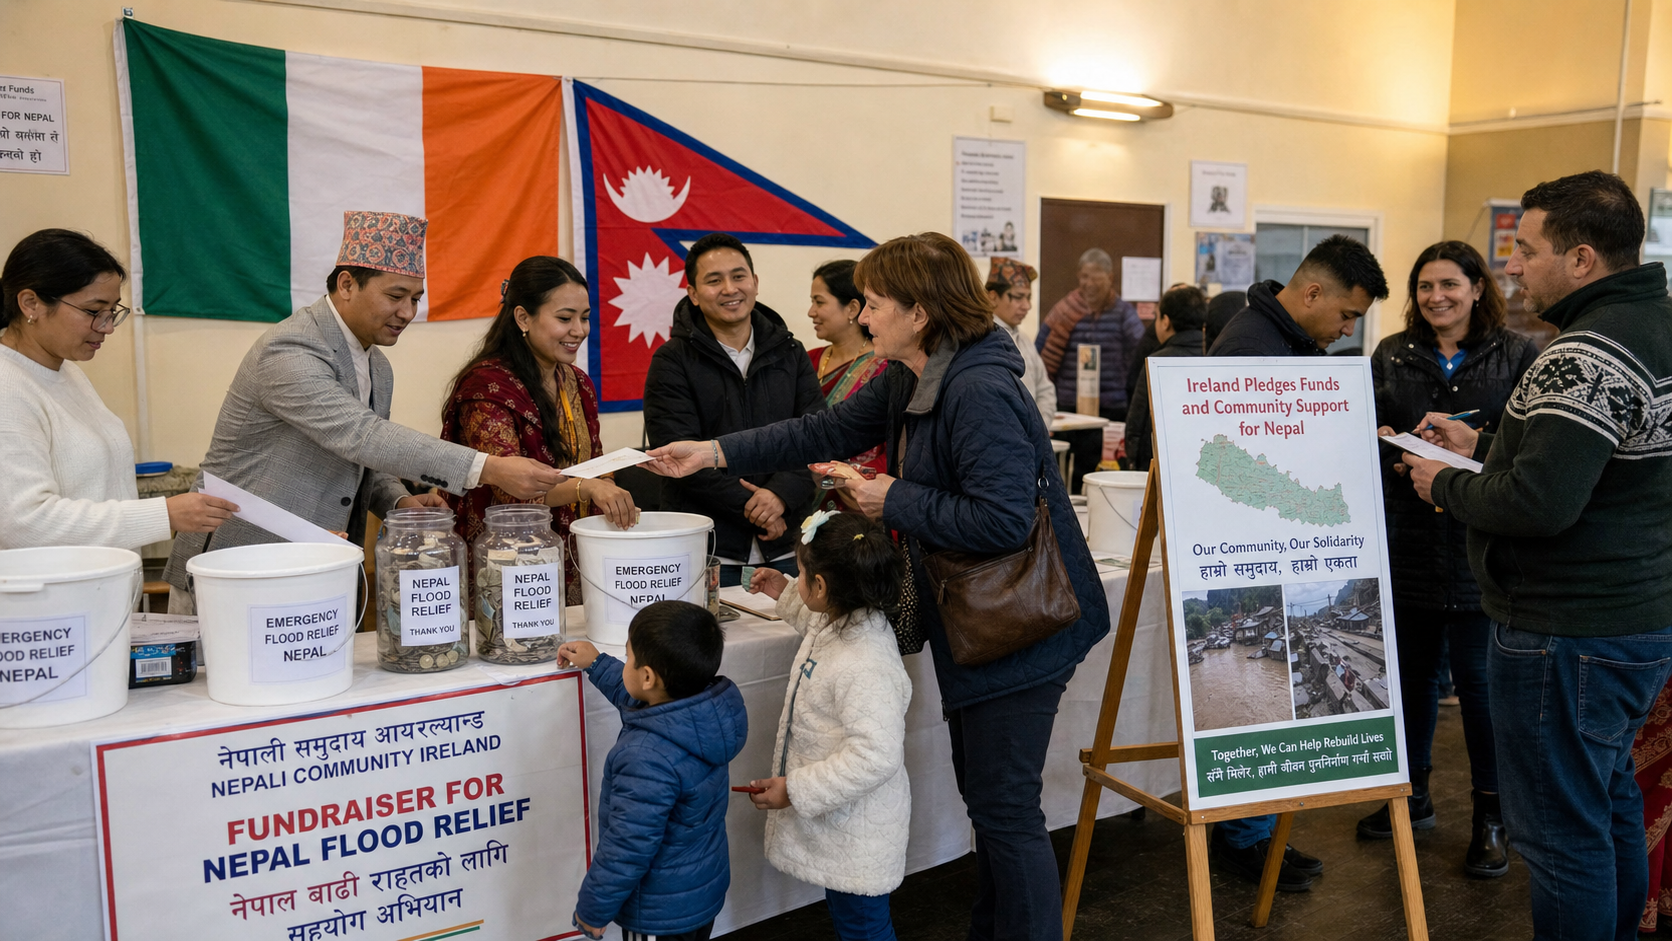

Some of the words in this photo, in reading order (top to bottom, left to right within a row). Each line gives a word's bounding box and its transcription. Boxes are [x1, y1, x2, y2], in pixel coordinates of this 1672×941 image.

[8, 84, 34, 94] Funds
[1, 111, 20, 120] FOR
[24, 112, 54, 122] NEPAL
[1186, 377, 1240, 393] Ireland
[1244, 377, 1297, 396] Pledges
[1300, 376, 1340, 392] Funds
[1182, 400, 1210, 415] and
[1214, 399, 1292, 418] Community
[1296, 398, 1350, 416] Support
[1238, 421, 1260, 436] for
[1264, 420, 1305, 440] Nepal
[1192, 543, 1216, 556] Our
[1220, 539, 1287, 555] Community,
[1289, 537, 1310, 550] Our
[1313, 534, 1365, 550] Solidarity
[615, 563, 682, 576] EMERGENCY
[1199, 560, 1227, 580] हाम्रो
[1234, 561, 1282, 580] समुदाय,
[1291, 554, 1318, 575] हाम्रो
[1324, 555, 1358, 572] एकता
[412, 577, 450, 589] NEPAL
[514, 572, 550, 584] NEPAL
[615, 580, 648, 590] FLOOD
[650, 577, 682, 589] RELIEF
[411, 590, 452, 603] FLOOD
[514, 586, 552, 598] FLOOD
[411, 604, 452, 616] RELIEF
[514, 598, 552, 610] RELIEF
[266, 608, 338, 628] EMERGENCY
[512, 620, 539, 630] THANK
[541, 618, 555, 626] YOU
[0, 628, 72, 644] ERGENCY
[265, 632, 304, 644] FLOOD
[307, 624, 339, 640] RELIEF
[410, 627, 438, 636] THANK
[440, 625, 455, 634] YOU
[29, 645, 75, 660] RELIEF
[284, 646, 326, 662] NEPAL
[0, 667, 58, 683] NEPAL
[218, 737, 286, 770] नेपाली
[294, 730, 367, 761] समुदाय
[374, 710, 486, 744] आयरल्यान्ड
[1211, 746, 1259, 764] Together,
[1260, 744, 1277, 755] We
[1278, 742, 1298, 753] Can
[1300, 738, 1322, 752] Help
[1324, 733, 1359, 748] Rebuild
[1360, 732, 1384, 744] Lives
[211, 770, 287, 798] NEPALI
[293, 749, 414, 784] COMMUNITY
[420, 734, 502, 763] IRELAND
[227, 785, 436, 846] FUNDRAISER
[446, 772, 506, 804] FOR
[202, 842, 311, 884] NEPAL
[320, 820, 424, 862] FLOOD
[434, 797, 532, 839] RELIEF
[229, 890, 298, 921] नेपाल
[307, 870, 360, 905] बाढी
[369, 852, 452, 892] राहतको
[460, 839, 510, 872] लागि
[376, 888, 464, 924] अभियान
